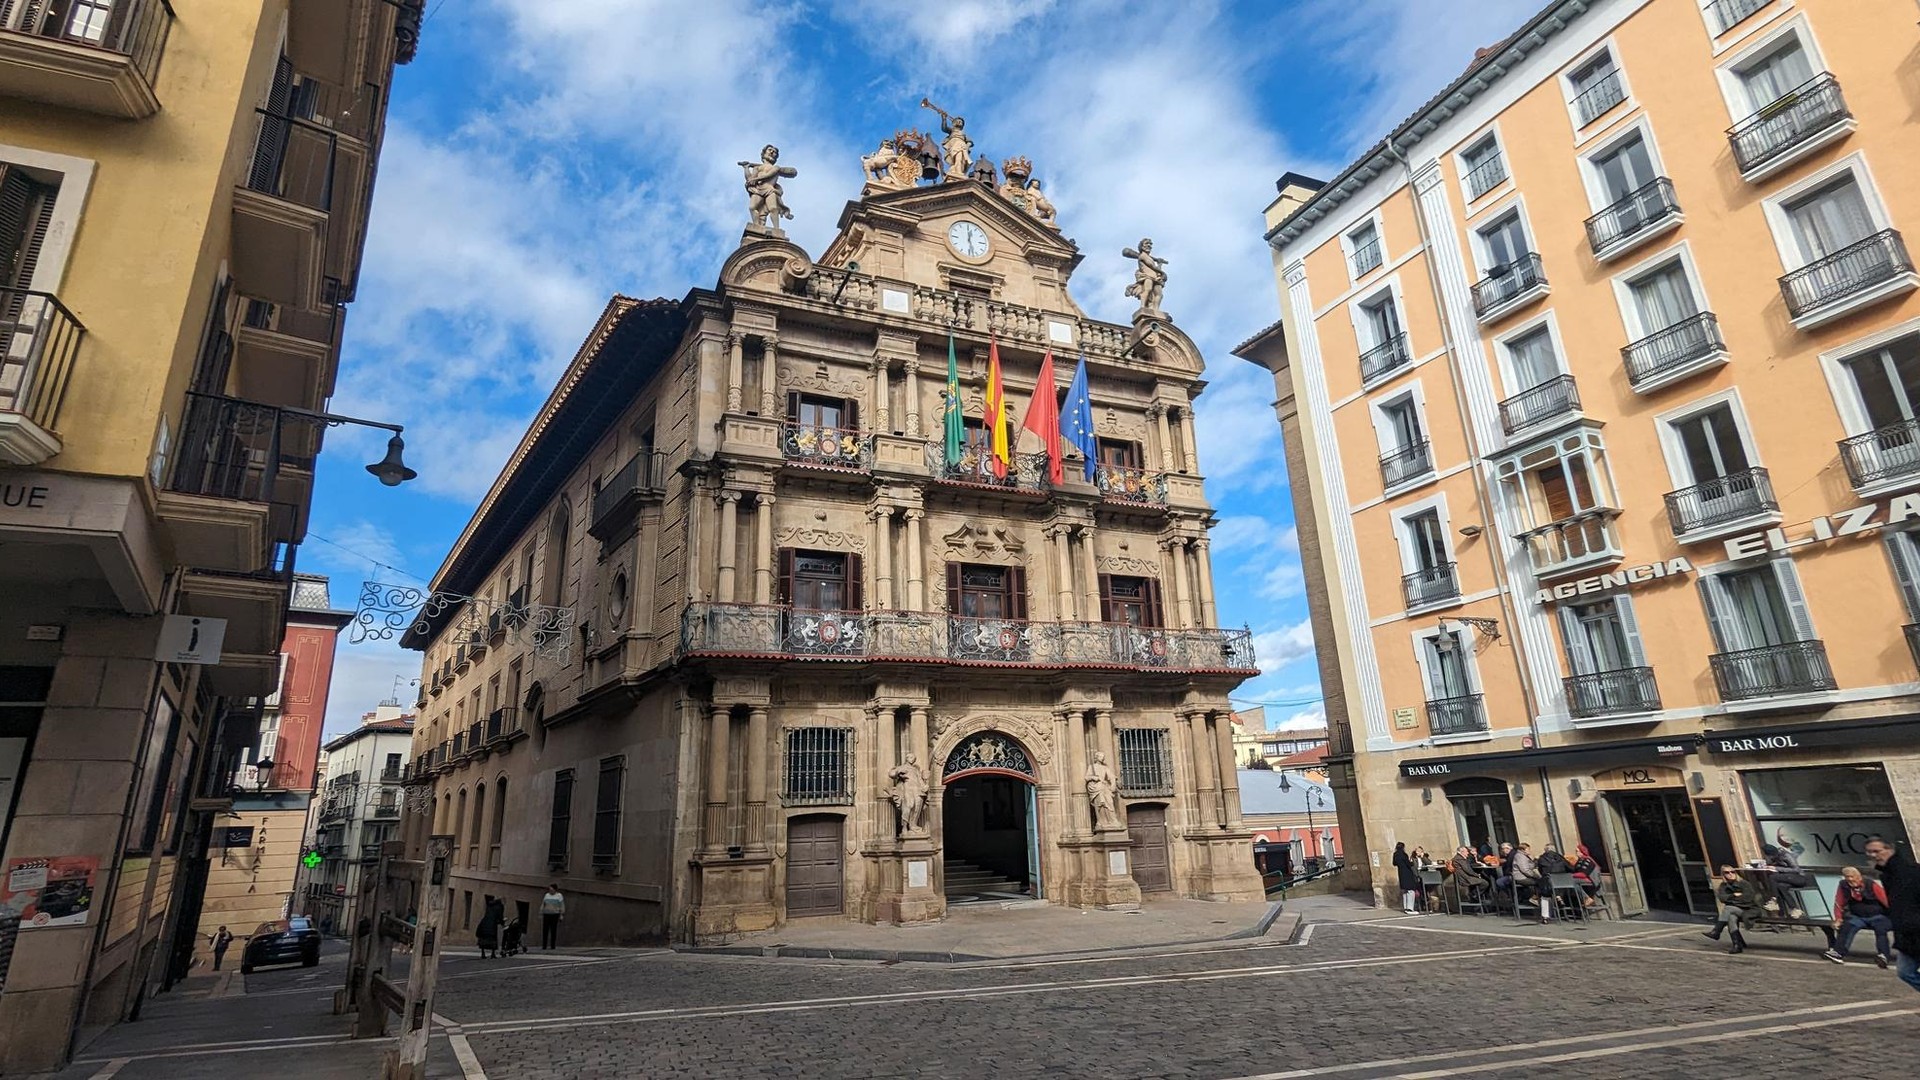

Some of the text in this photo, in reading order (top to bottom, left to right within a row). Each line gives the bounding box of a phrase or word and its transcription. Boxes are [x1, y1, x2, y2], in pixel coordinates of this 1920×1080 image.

[0, 485, 48, 508] UE
[1534, 556, 1694, 605] AGENCIA
[1720, 735, 1799, 752] BAR MOL
[1407, 764, 1451, 776] BAR MOL
[1623, 769, 1655, 783] MOL
[248, 817, 270, 894] FARMACIA
